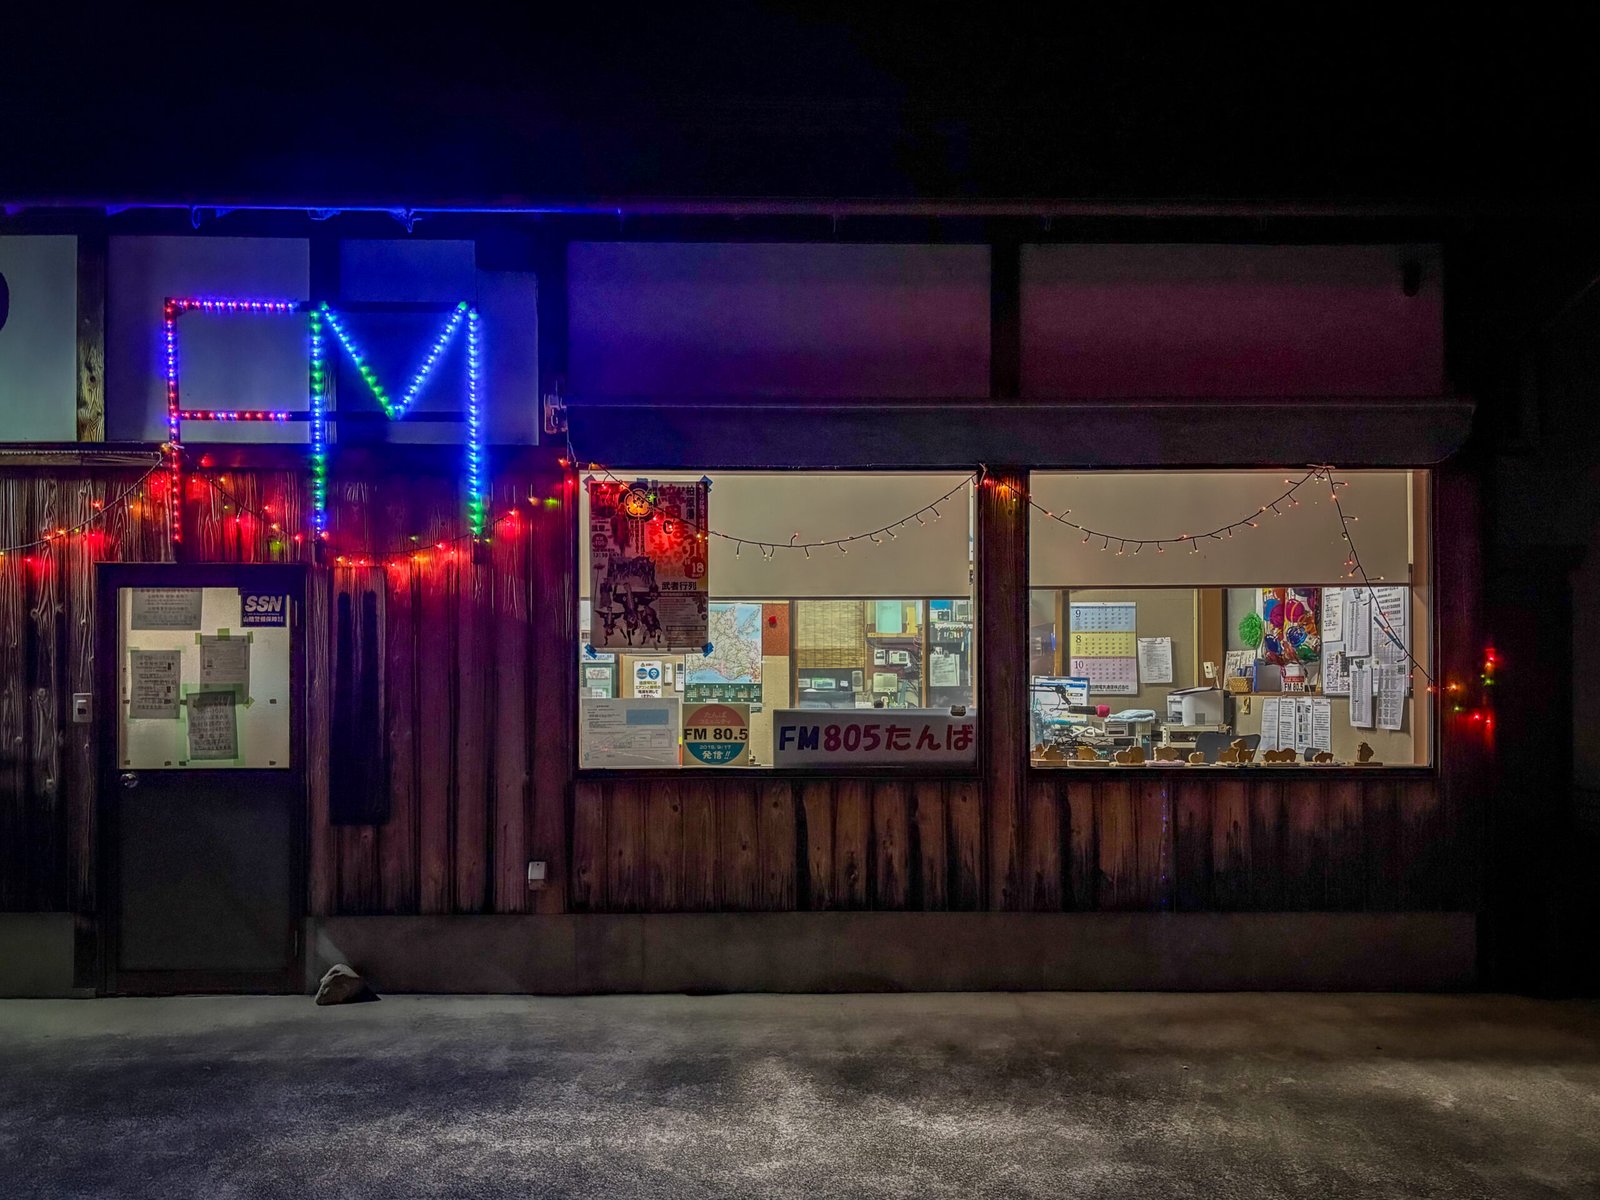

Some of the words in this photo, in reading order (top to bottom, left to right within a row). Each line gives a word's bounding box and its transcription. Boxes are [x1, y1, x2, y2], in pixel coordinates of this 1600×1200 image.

[164, 297, 484, 545] FM
[692, 562, 705, 573] 18
[661, 581, 697, 592] 武者行列
[244, 595, 283, 612] SSN
[1074, 660, 1084, 669] 10
[683, 728, 707, 740] FM
[713, 728, 748, 740] 80.5
